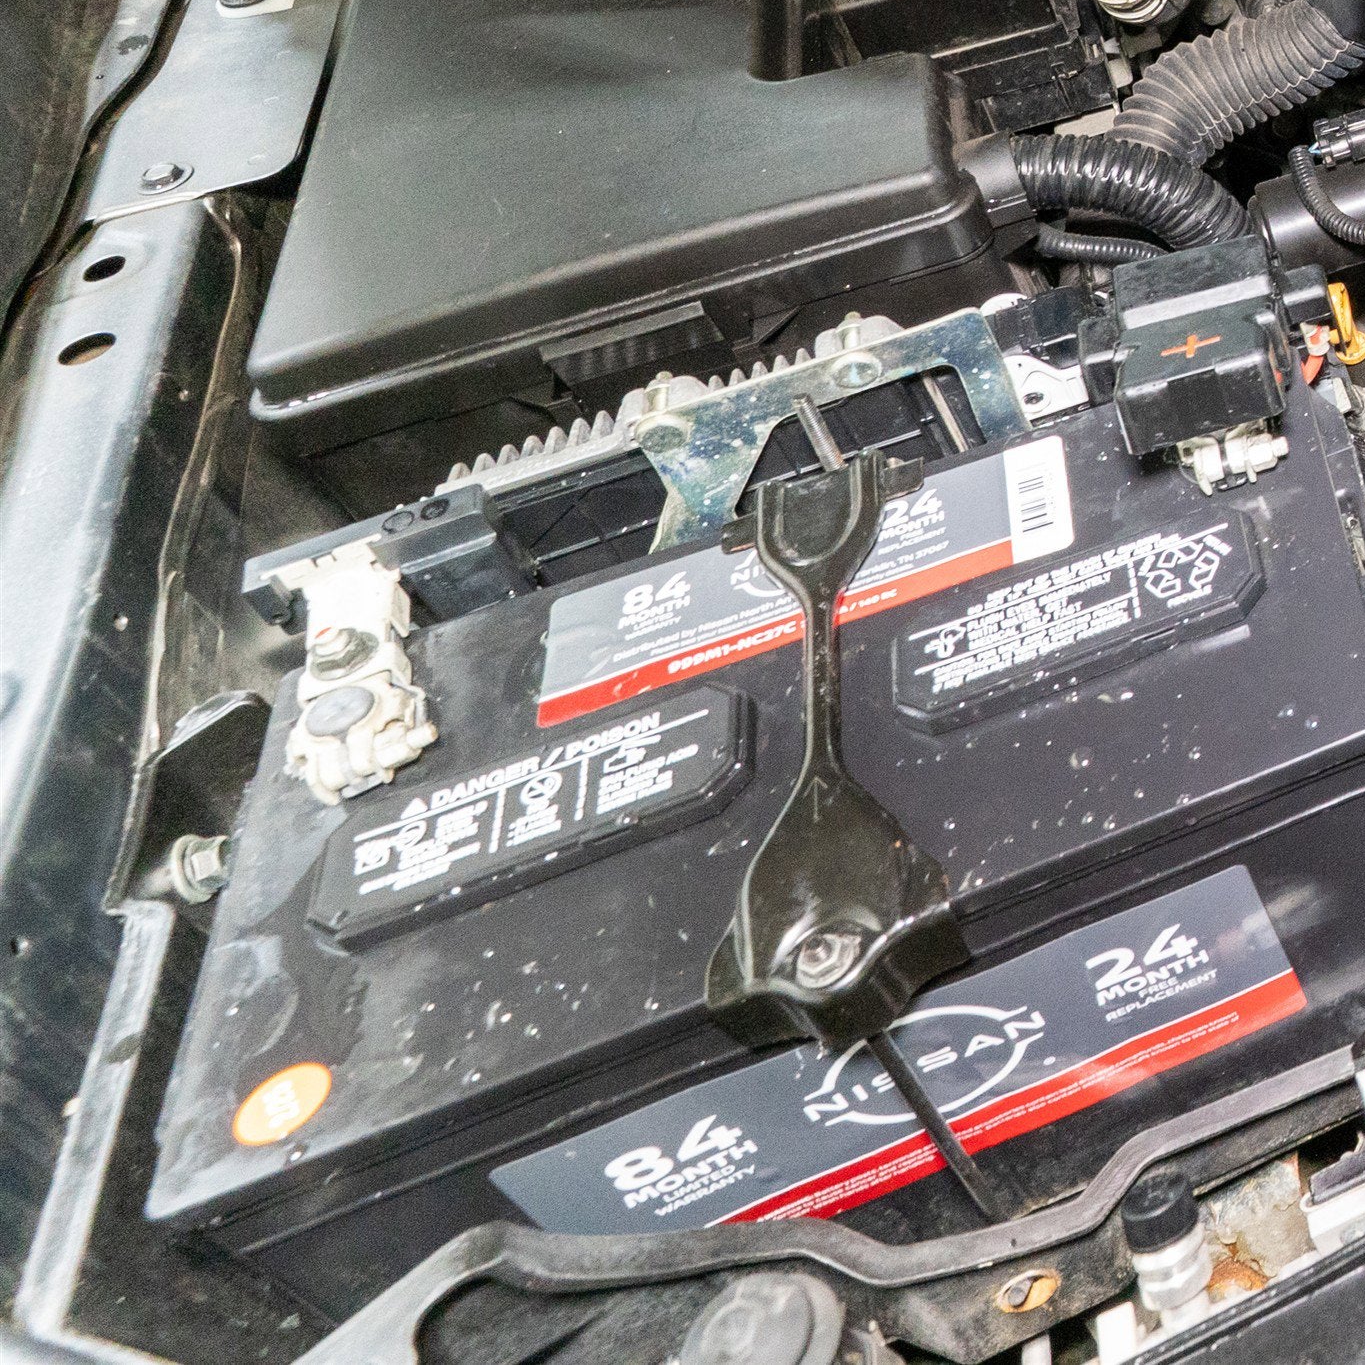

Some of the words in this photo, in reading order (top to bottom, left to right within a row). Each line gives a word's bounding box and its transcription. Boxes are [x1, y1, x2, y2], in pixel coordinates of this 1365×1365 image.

[877, 510, 946, 542] MONTH
[878, 487, 945, 530] 24
[617, 594, 691, 630] MONTH
[622, 570, 692, 614] 84
[612, 631, 684, 663] Distributed
[695, 614, 739, 633] Nissan
[739, 601, 778, 620] North
[430, 755, 541, 810] DANGER
[565, 712, 661, 760] POISON
[1085, 923, 1199, 991] 24
[1096, 949, 1210, 1007] MONTH
[1105, 968, 1218, 1022] REPLACEMENT
[1138, 976, 1179, 998] FREE
[803, 1010, 1047, 1123] NISSAN
[604, 1114, 743, 1191] 84
[623, 1139, 758, 1209] MONTH
[654, 1163, 755, 1216] WARRANTY
[662, 1164, 736, 1203] LIMITED
